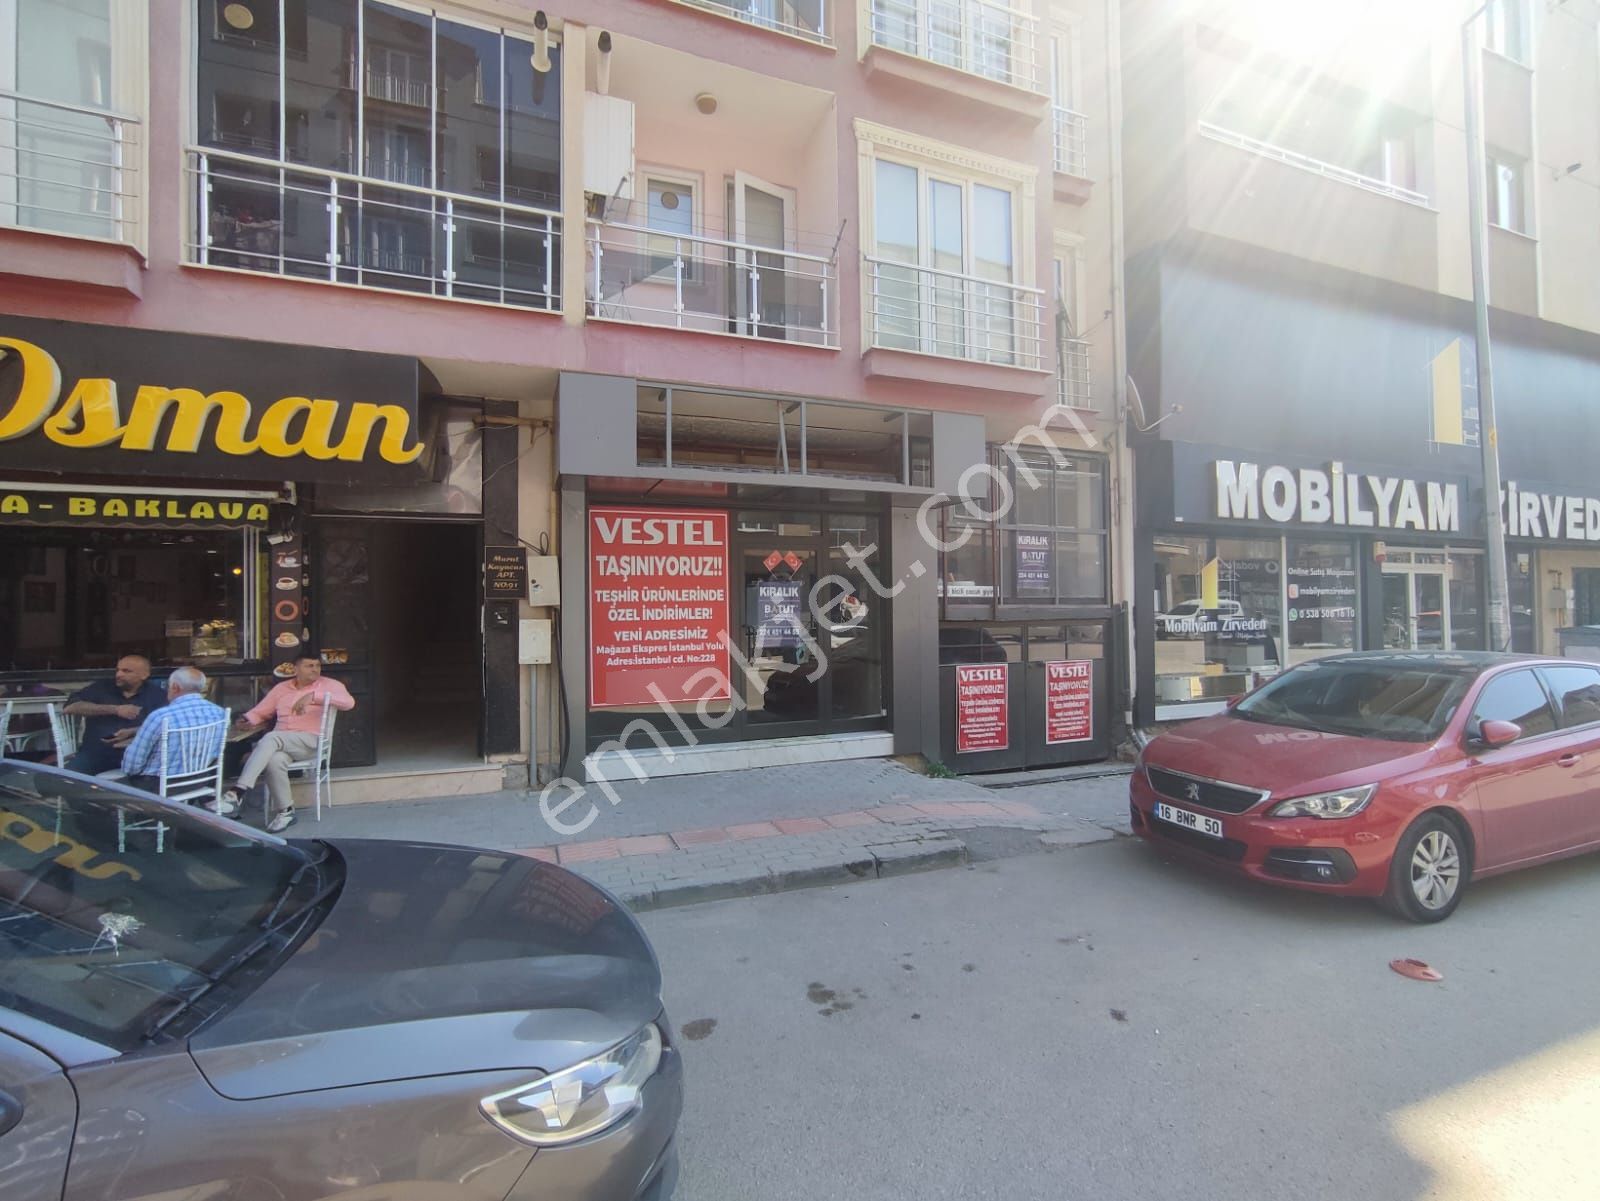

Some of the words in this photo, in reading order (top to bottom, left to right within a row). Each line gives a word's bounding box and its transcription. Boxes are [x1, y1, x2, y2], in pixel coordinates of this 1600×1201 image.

[1215, 460, 1459, 532] MOBİLYAM
[69, 497, 269, 521] BAKLAVA
[594, 517, 723, 545] VESTEL
[596, 555, 722, 582] TAŞINIYORUZ!!
[1288, 567, 1308, 576] Online
[595, 587, 639, 605] TEŞHİR
[642, 586, 725, 602] ÜRÜNLERİNDE
[608, 605, 640, 621] ÖZEL
[642, 605, 712, 620] İNDİRİMLER!
[614, 628, 643, 641] YENİ
[644, 627, 708, 640] ADRESİMİZ
[1165, 619, 1217, 634] Mobilyam
[632, 644, 667, 654] Ekspres
[706, 641, 725, 650] Yolu
[960, 669, 1004, 682] VESTEL
[1050, 665, 1088, 678] VESTEL
[1160, 804, 1171, 819] 16
[1205, 820, 1220, 835] 50
